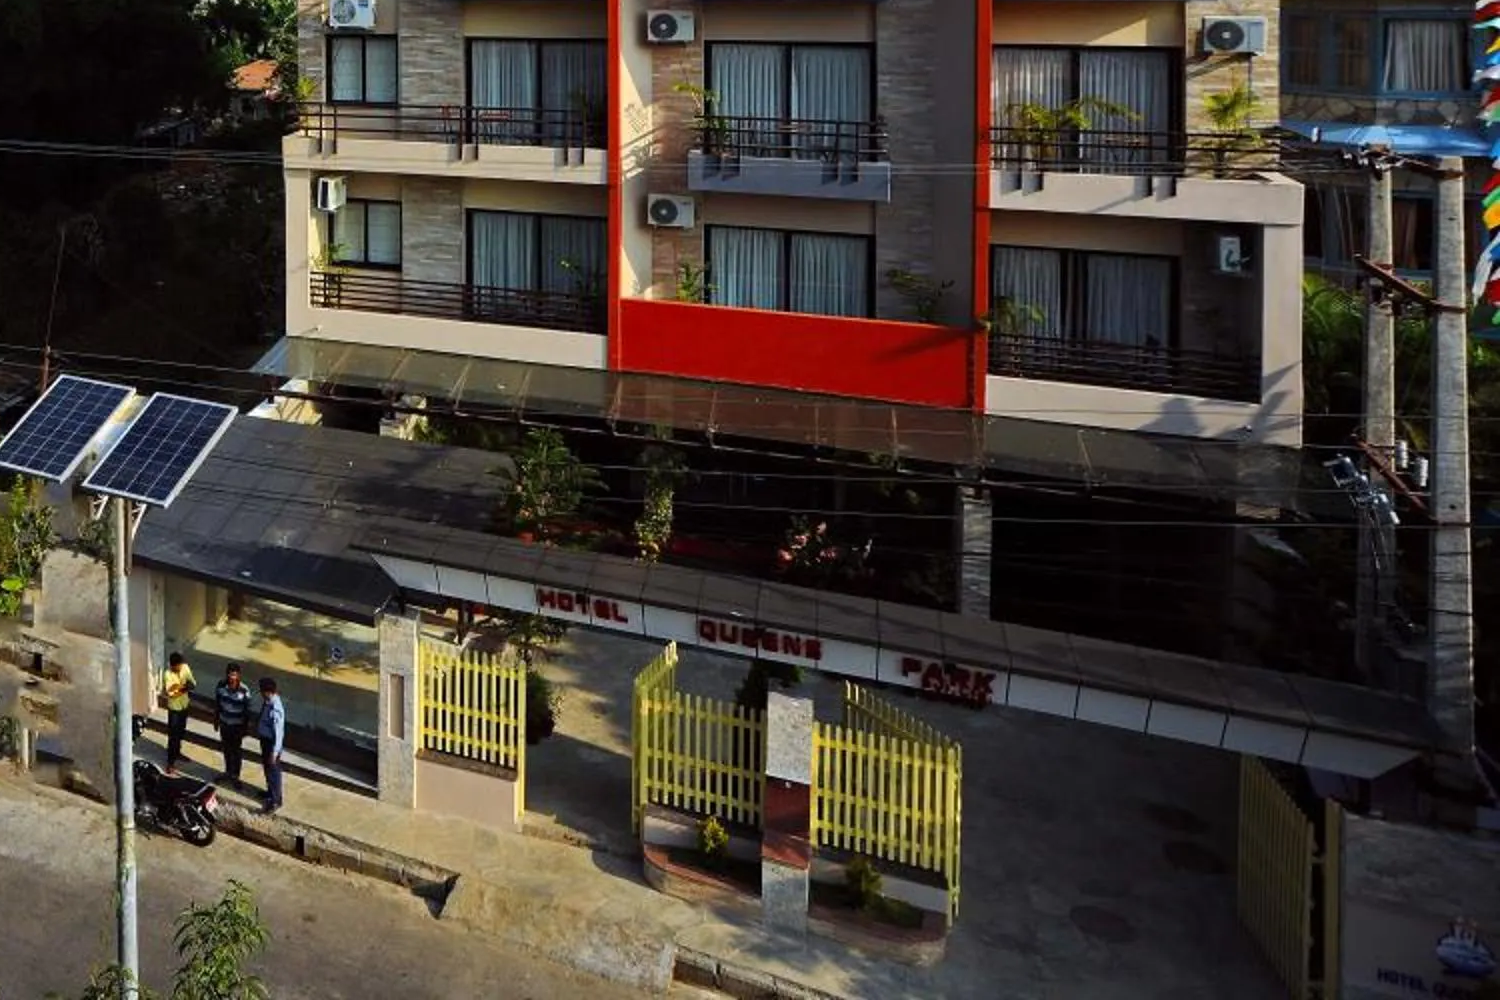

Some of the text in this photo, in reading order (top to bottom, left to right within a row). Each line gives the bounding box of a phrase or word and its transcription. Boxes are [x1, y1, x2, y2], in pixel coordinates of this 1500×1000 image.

[536, 588, 997, 697] HOTEL QUEENS PARK
[1377, 967, 1428, 993] HOTEL
